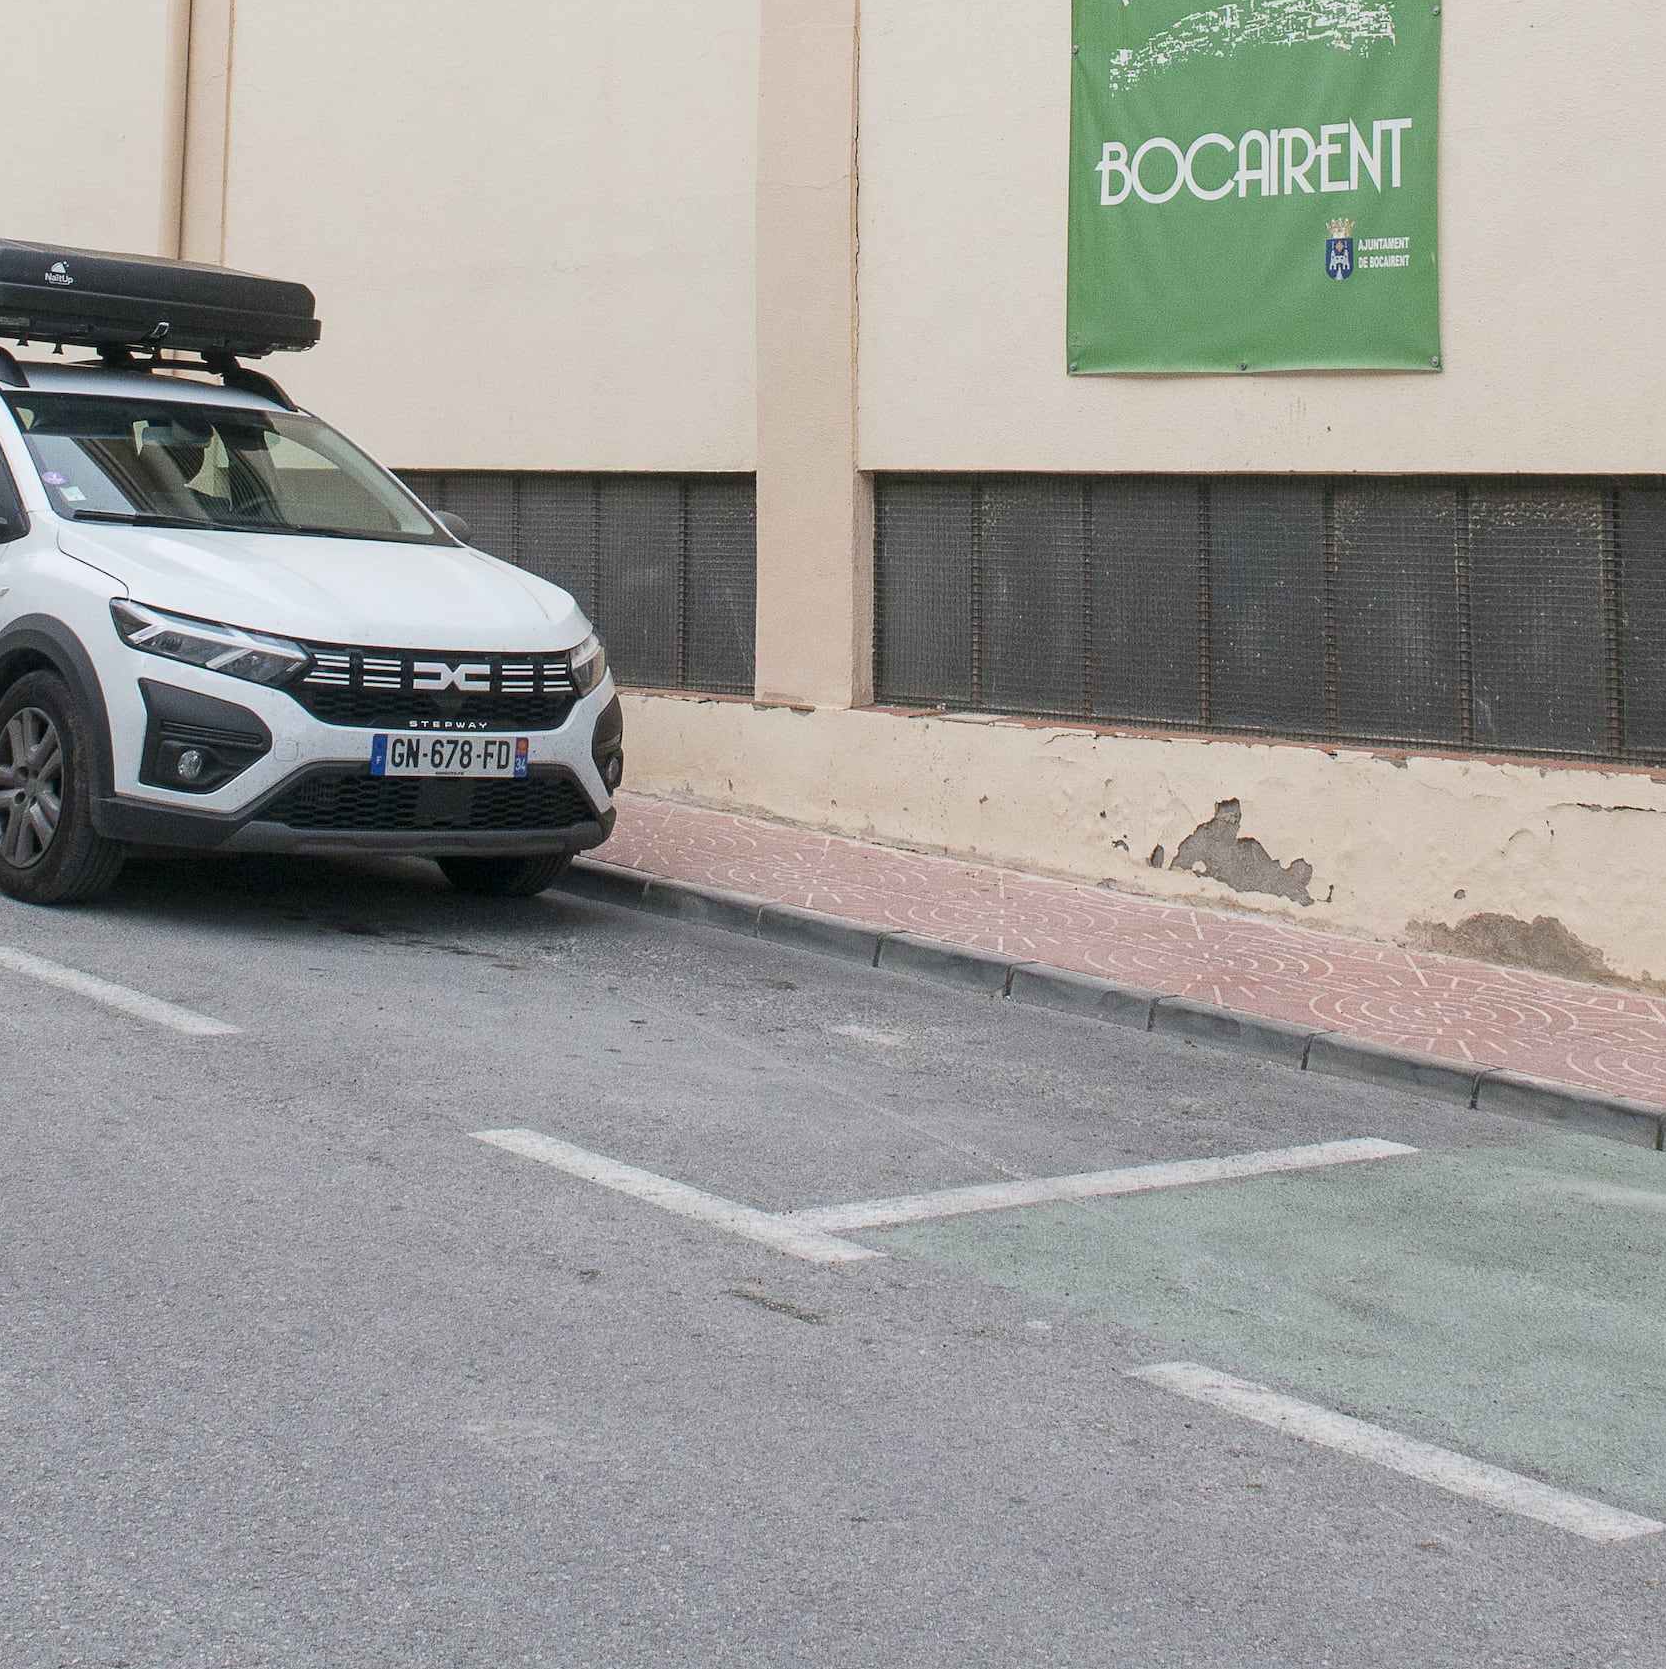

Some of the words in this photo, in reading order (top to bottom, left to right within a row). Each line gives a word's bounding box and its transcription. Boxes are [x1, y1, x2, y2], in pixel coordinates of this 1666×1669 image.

[1094, 117, 1413, 207] BOCAIRENT
[1357, 236, 1410, 251] AJUNTAMENT
[1358, 256, 1369, 269] DE
[1369, 254, 1410, 269] BOCAIRENT
[408, 720, 488, 730] STEPWAY
[391, 738, 511, 770] GN-678-FD
[515, 757, 527, 772] 34
